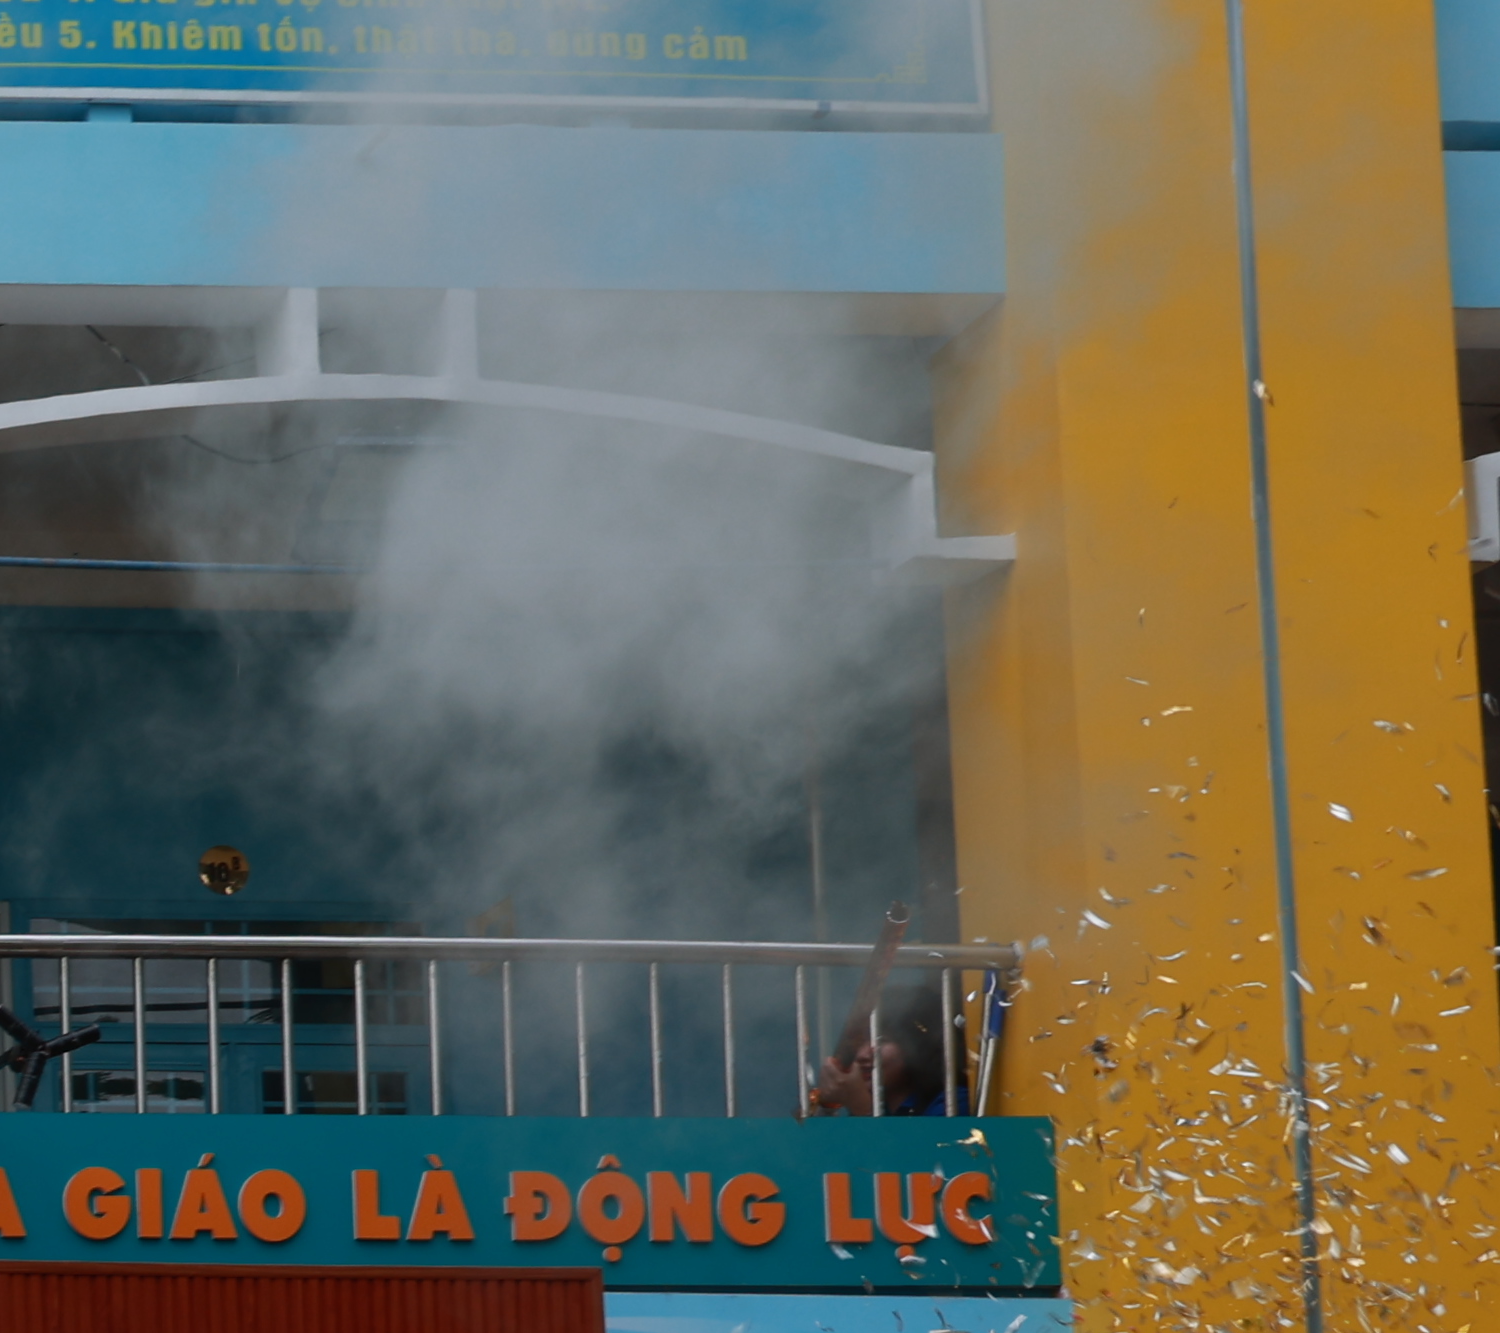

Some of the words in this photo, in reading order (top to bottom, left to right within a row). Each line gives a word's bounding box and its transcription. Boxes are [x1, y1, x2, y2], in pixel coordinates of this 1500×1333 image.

[59, 20, 97, 49] 5.
[113, 18, 243, 51] Khiêm
[62, 1153, 307, 1243] GIÁO
[351, 1154, 476, 1242] LÀ
[503, 1154, 786, 1263] ĐỘNG
[822, 1170, 995, 1261] LỰC
